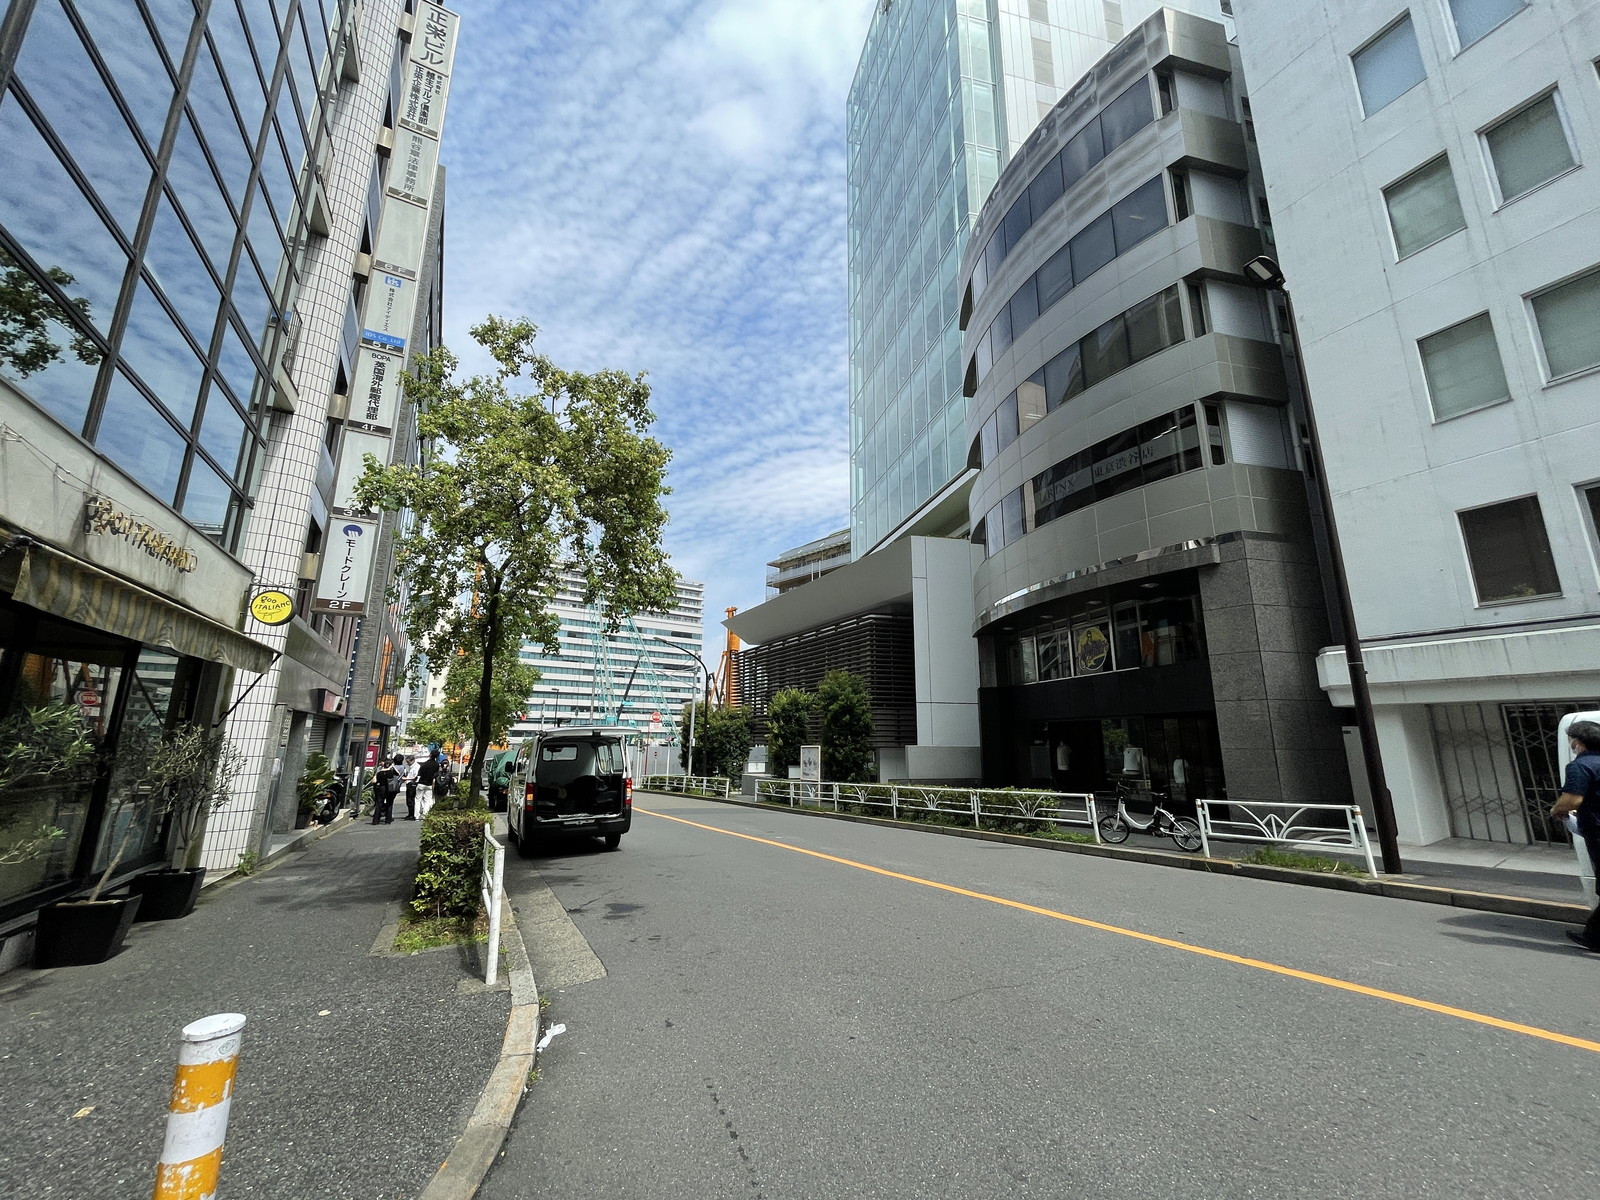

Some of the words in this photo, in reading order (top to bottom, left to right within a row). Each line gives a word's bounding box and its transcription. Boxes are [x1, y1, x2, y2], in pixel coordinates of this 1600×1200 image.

[419, 7, 448, 65] 正栄ビル
[371, 352, 391, 363] BOPA
[361, 423, 377, 432] 4F
[336, 538, 356, 599] モードクレーン
[260, 595, 277, 604] goo
[328, 600, 352, 610] 2F
